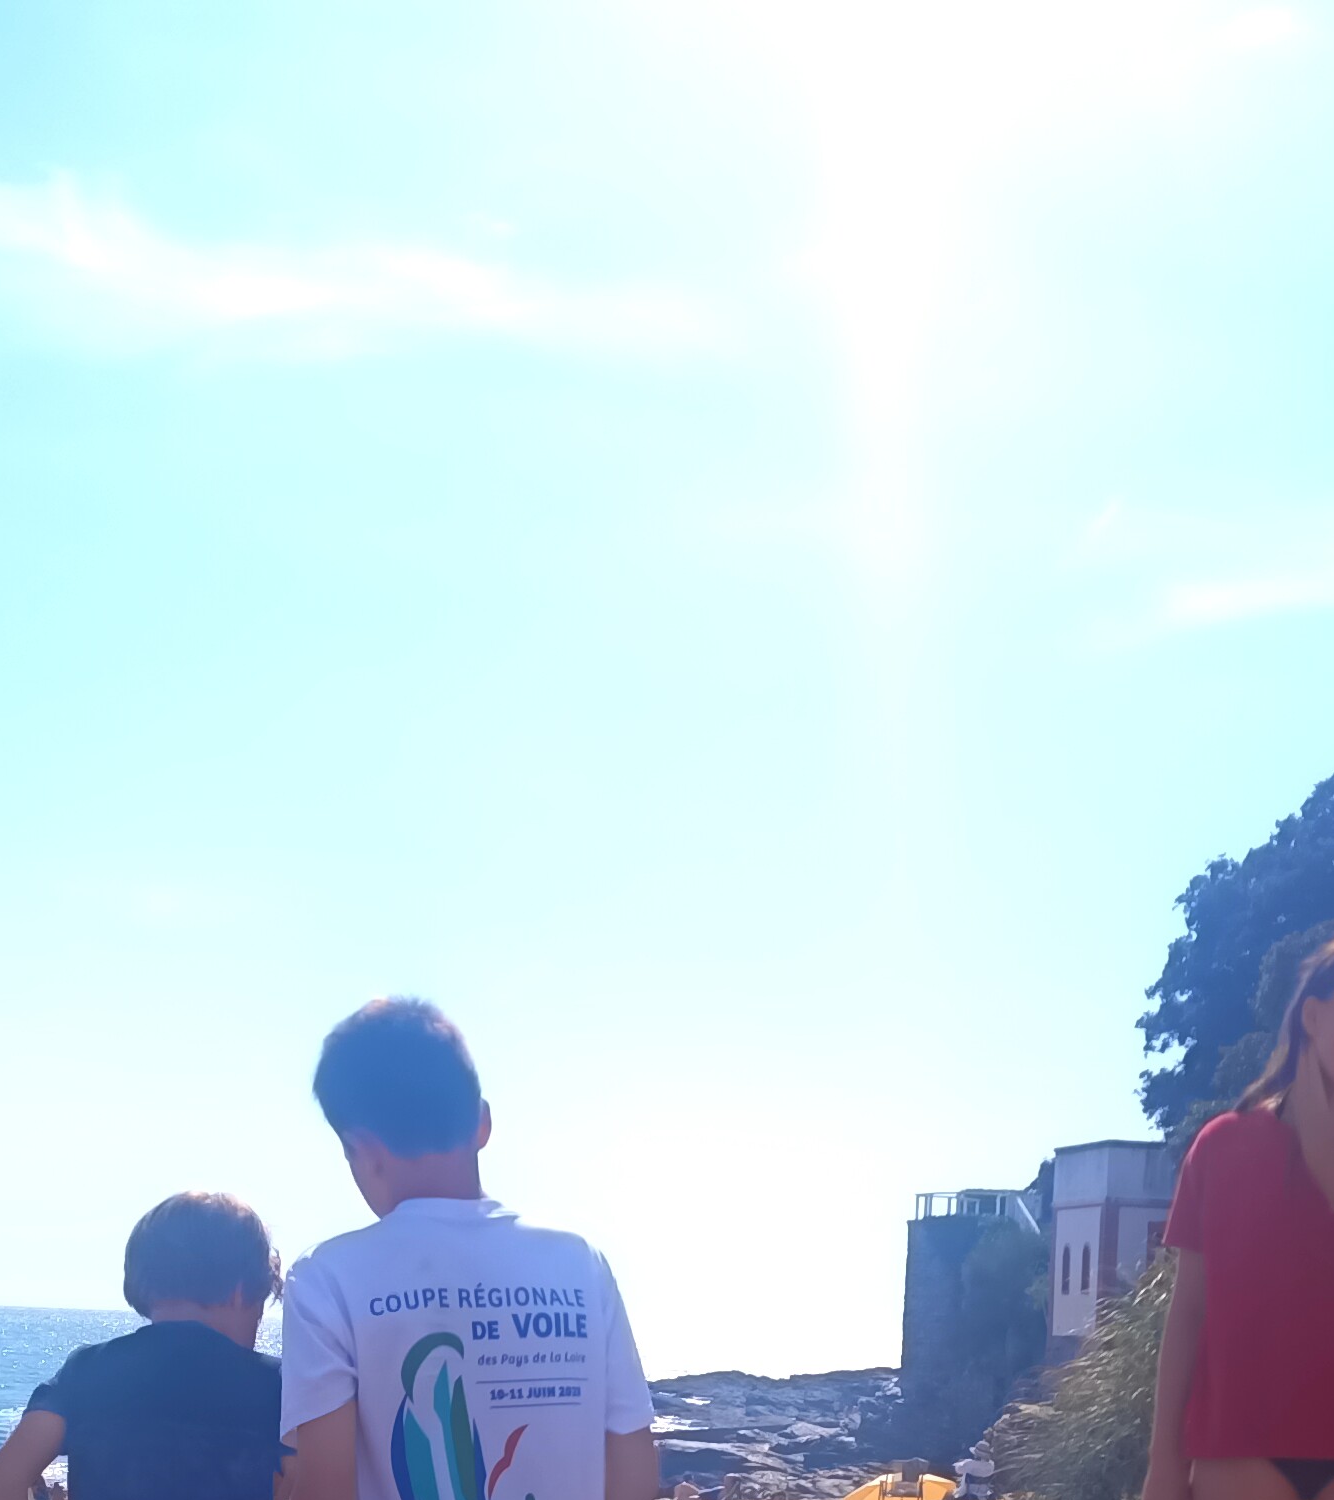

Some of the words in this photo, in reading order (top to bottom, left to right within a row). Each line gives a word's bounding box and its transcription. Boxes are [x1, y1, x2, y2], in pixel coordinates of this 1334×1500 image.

[370, 1288, 449, 1316] COUPE
[458, 1283, 585, 1308] RÉGIONALE
[471, 1321, 500, 1340] DE
[511, 1312, 588, 1339] VOILE
[477, 1354, 498, 1366] des
[501, 1354, 529, 1367] Pays
[532, 1352, 546, 1363] de
[550, 1351, 562, 1363] la
[526, 1386, 556, 1399] JUIN
